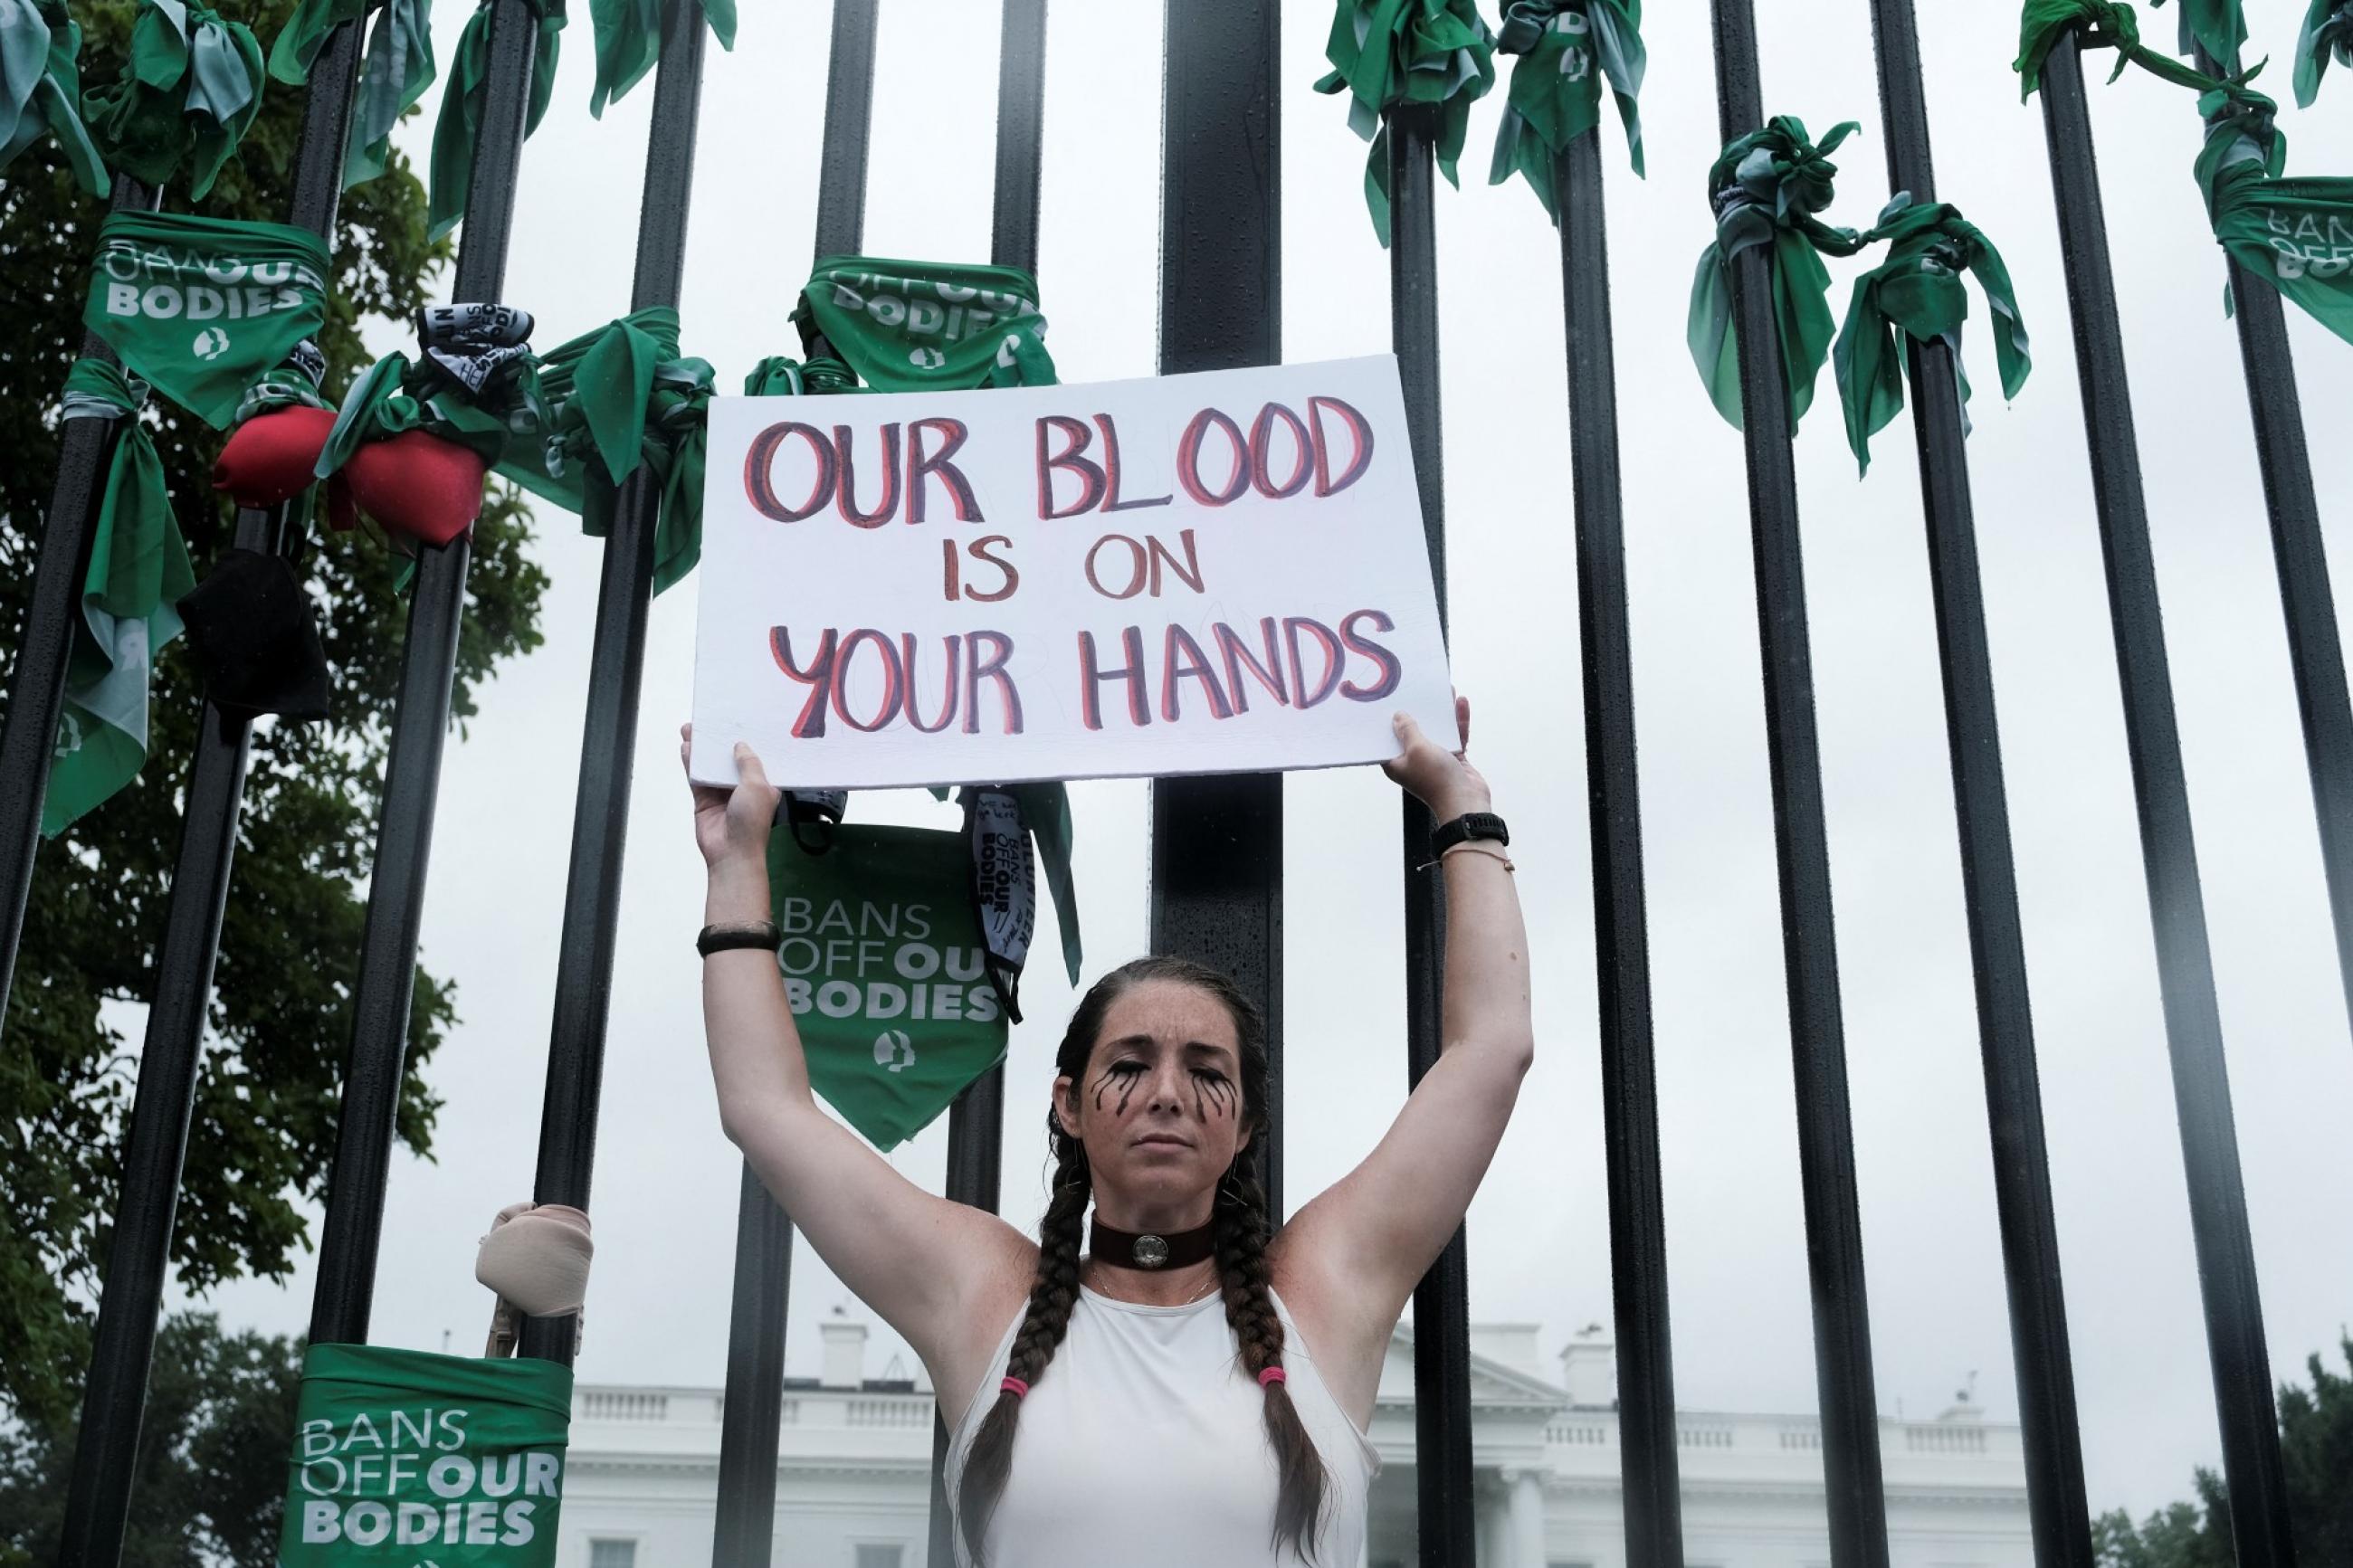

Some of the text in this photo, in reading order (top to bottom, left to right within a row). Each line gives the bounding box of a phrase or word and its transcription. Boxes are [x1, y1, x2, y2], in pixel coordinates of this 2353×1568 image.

[107, 282, 304, 320] BODIES
[744, 395, 1375, 530] OUR BLOOD
[944, 529, 1205, 603] IS ON
[769, 609, 1401, 739] YOUR HANDS
[978, 832, 995, 906] BODIES
[994, 833, 1010, 913] OFF OUR
[784, 898, 931, 938] BANS
[777, 938, 986, 981] OFF OU
[786, 978, 999, 1022] BODIES
[302, 1409, 469, 1457] BANS
[300, 1452, 559, 1499] OFF OUR
[301, 1500, 537, 1547] BODIES
